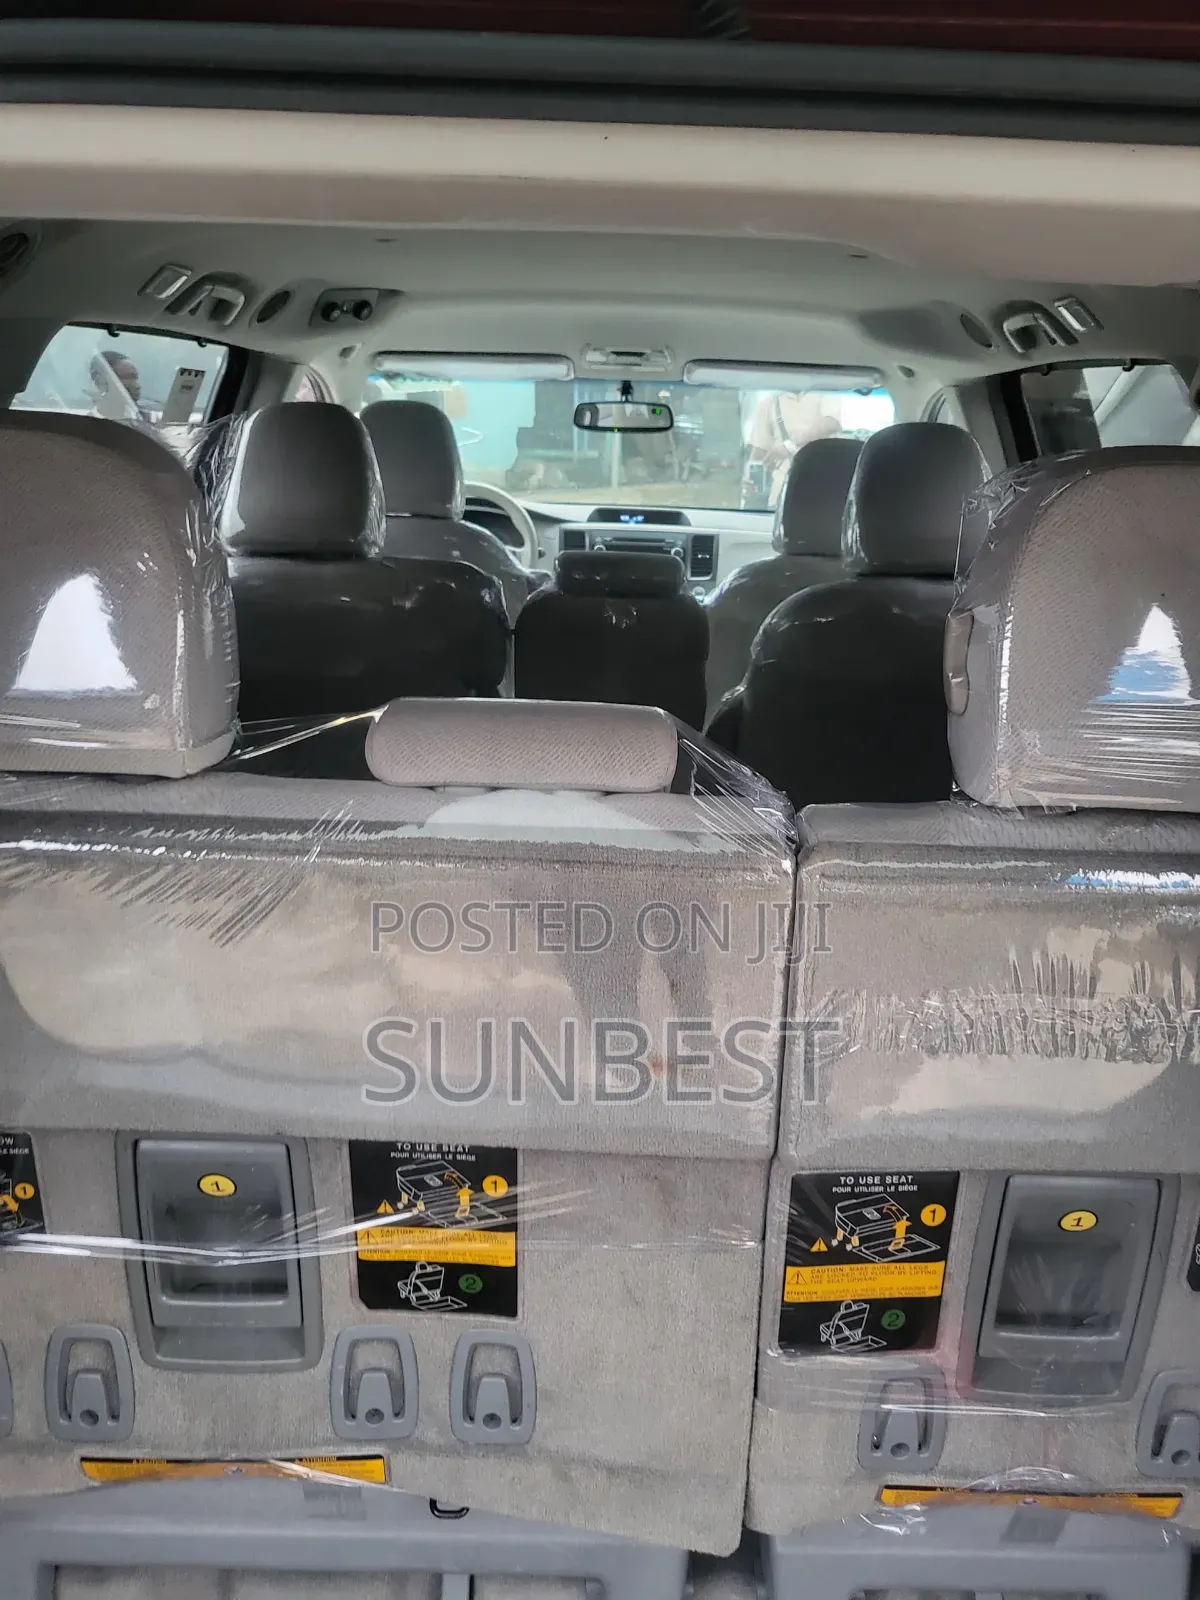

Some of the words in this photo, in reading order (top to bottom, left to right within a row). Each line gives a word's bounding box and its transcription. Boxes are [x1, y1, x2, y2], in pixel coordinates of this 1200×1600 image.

[397, 1142, 411, 1151] TO
[416, 1143, 437, 1152] USE
[442, 1143, 469, 1153] SEAT
[390, 1151, 410, 1159] POUR
[413, 1152, 441, 1160] UTILISER
[491, 1179, 498, 1193] 1
[840, 1176, 854, 1185] TO
[859, 1176, 880, 1184] USE
[886, 1175, 914, 1184] SEAT
[210, 1181, 225, 1192] 1
[929, 1208, 937, 1223] 1
[1070, 1216, 1084, 1228] 1
[465, 1277, 476, 1291] 2
[888, 1312, 900, 1327] 2
